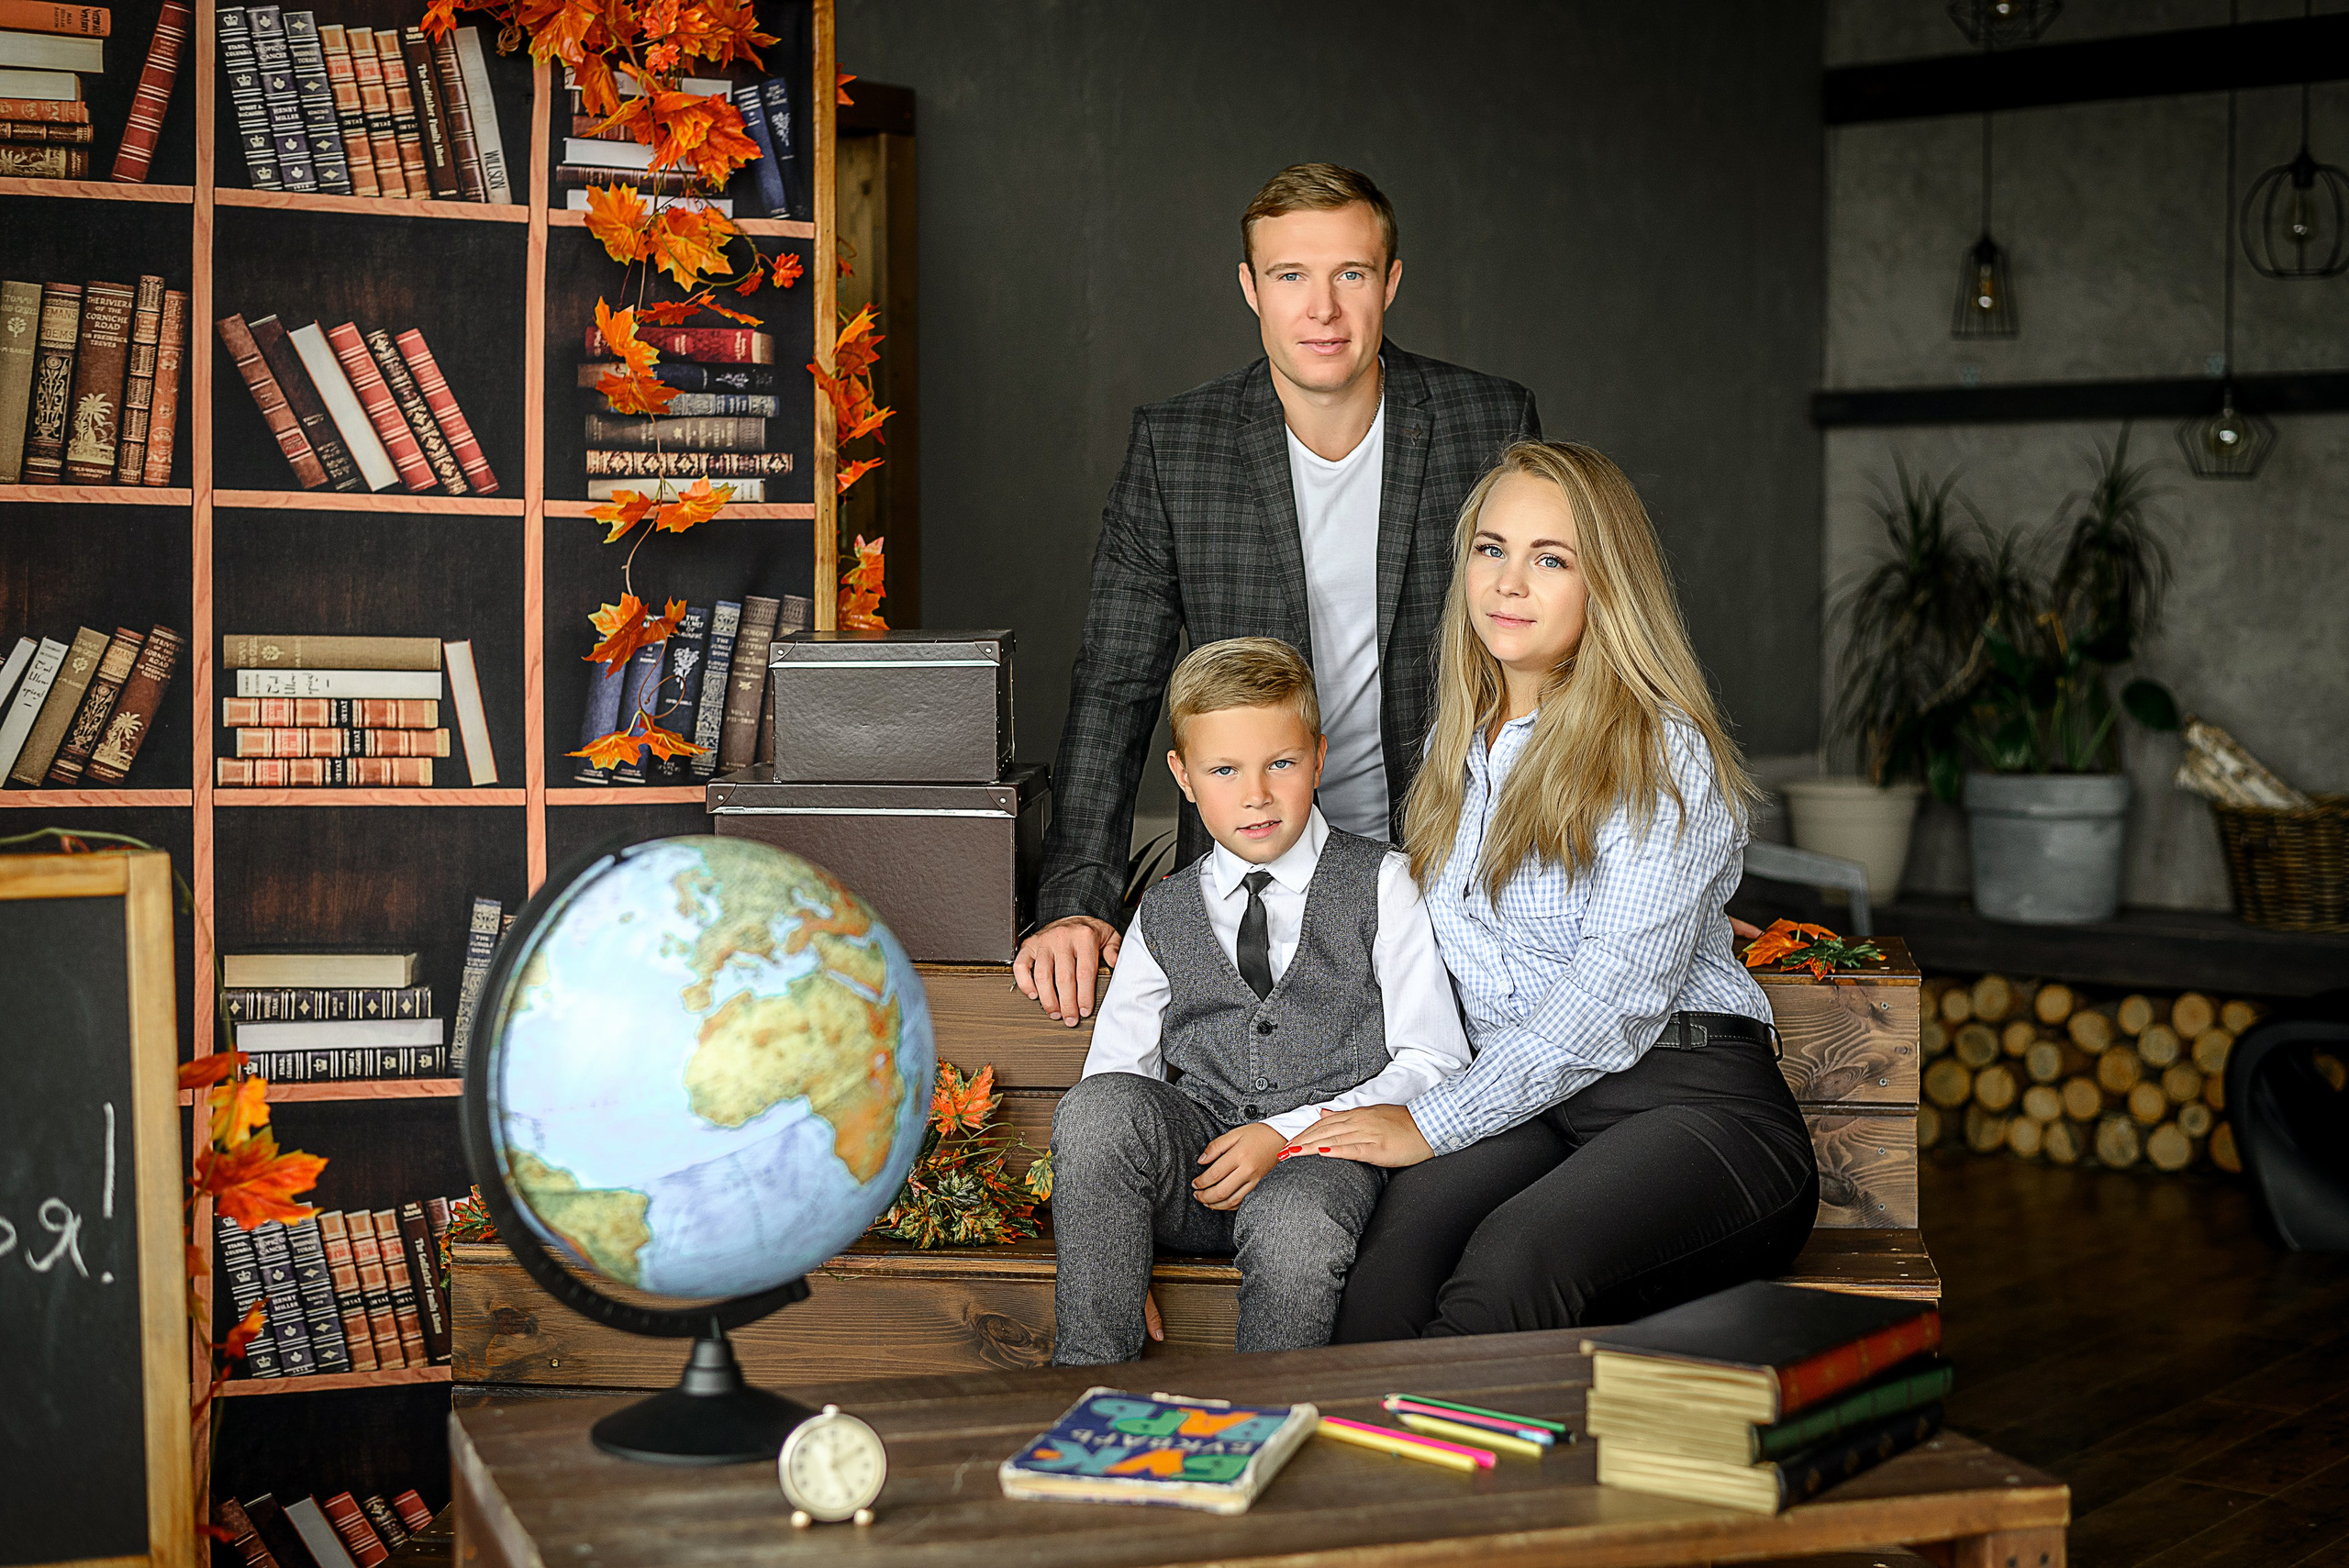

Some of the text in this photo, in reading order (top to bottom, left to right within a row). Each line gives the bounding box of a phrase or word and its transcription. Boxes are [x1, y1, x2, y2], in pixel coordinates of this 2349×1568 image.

[260, 52, 287, 61] CANCER
[417, 63, 429, 79] The
[421, 80, 436, 117] Godfather
[275, 113, 299, 121] MILLER
[429, 118, 441, 143] Family
[484, 150, 507, 190] WILLSON
[87, 296, 132, 308] THE RIVIERA
[85, 312, 128, 324] CORNICHE
[95, 321, 121, 330] ROAD
[41, 328, 75, 340] POEMS
[93, 333, 128, 343] FREDERICK
[90, 339, 117, 348] TREVES
[149, 656, 169, 668] ROAD
[415, 1237, 425, 1252] The
[273, 1295, 296, 1305] HENRY
[274, 1302, 299, 1311] MILLER
